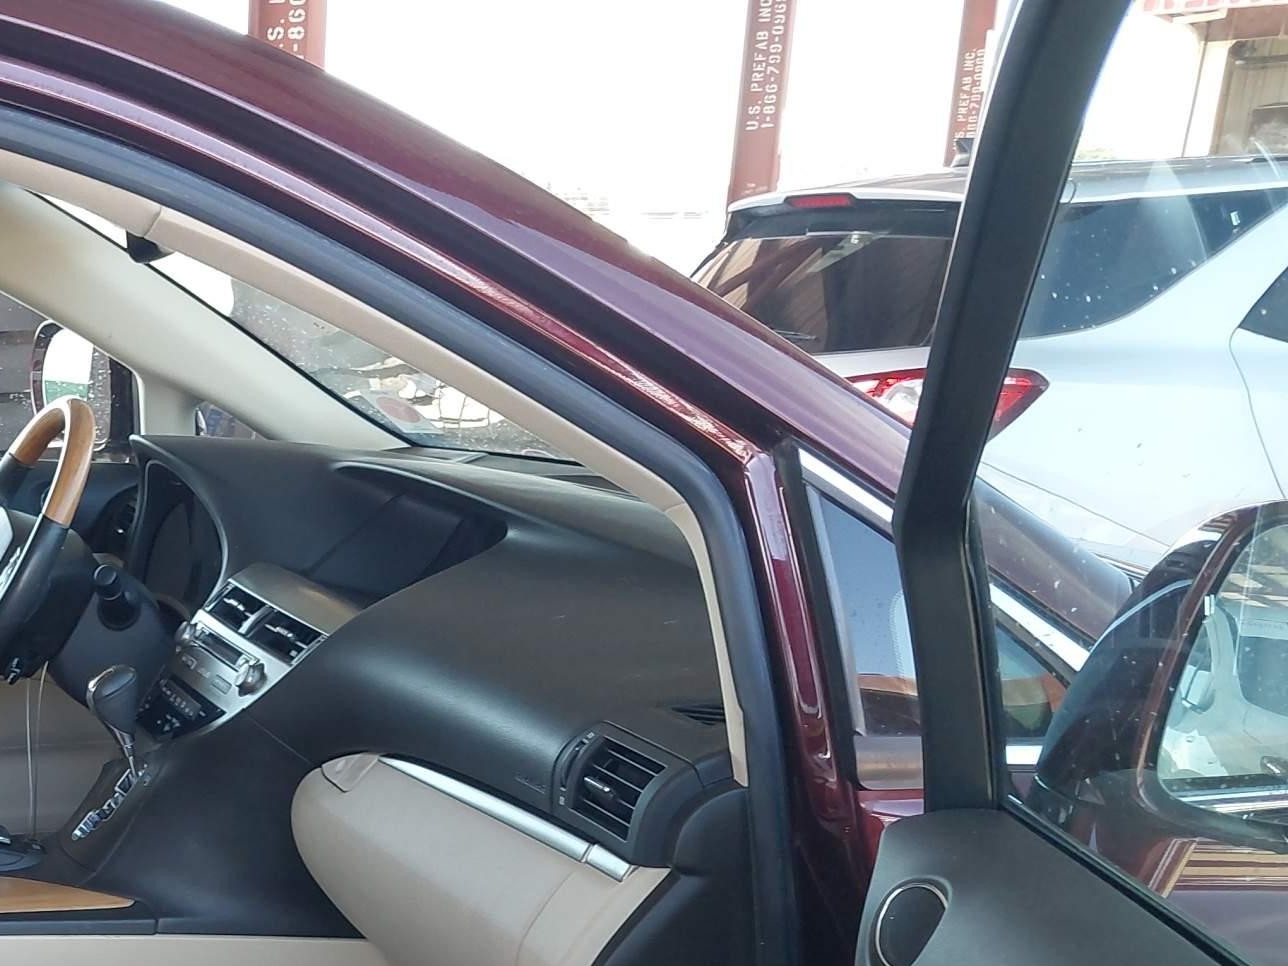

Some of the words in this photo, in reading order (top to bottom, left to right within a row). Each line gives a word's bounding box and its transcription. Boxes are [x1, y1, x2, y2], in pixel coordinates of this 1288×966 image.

[750, 31, 769, 92] PREFAB
[760, 0, 787, 128] 1-866-799-096
[745, 100, 762, 131] U.S.
